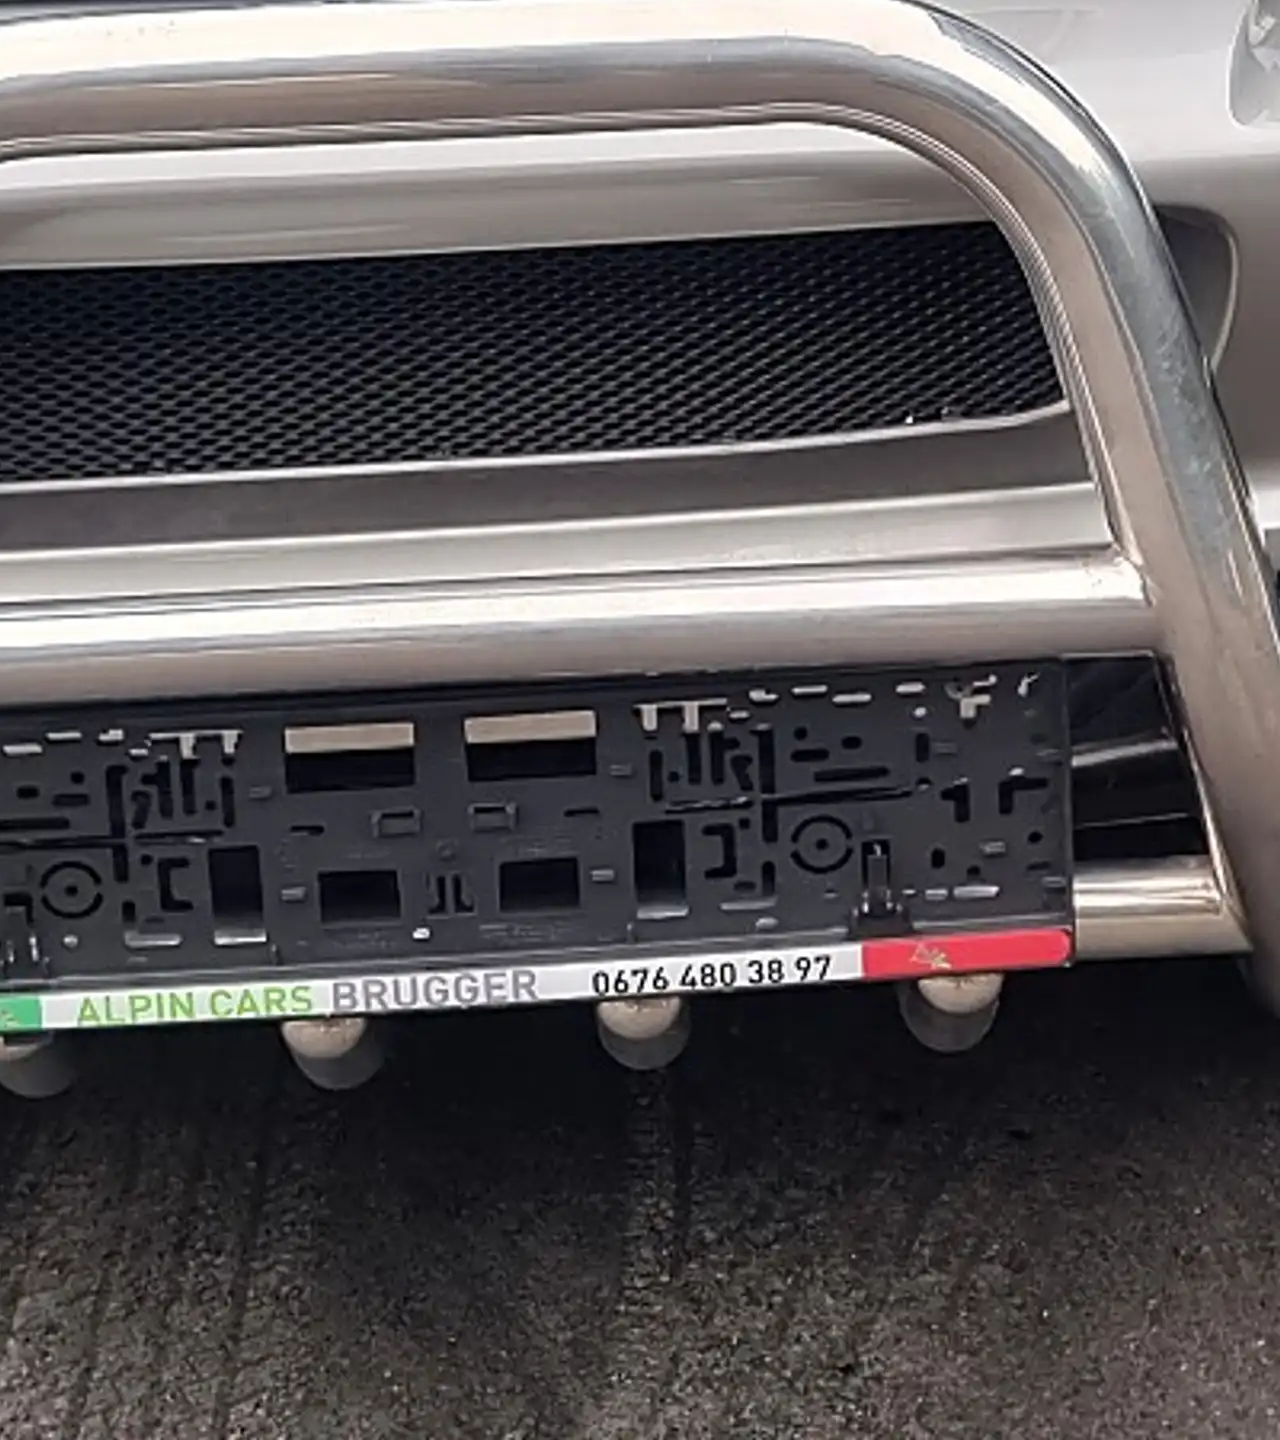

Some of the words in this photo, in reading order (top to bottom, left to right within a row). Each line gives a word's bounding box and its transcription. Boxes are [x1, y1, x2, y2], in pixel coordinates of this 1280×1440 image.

[77, 991, 195, 1027] ALPIN
[209, 985, 313, 1017] CARS
[331, 968, 540, 1010] BRUGGER
[592, 966, 670, 996] 0676
[679, 962, 738, 989] 480
[747, 958, 785, 984] 38
[793, 954, 832, 981] 97
